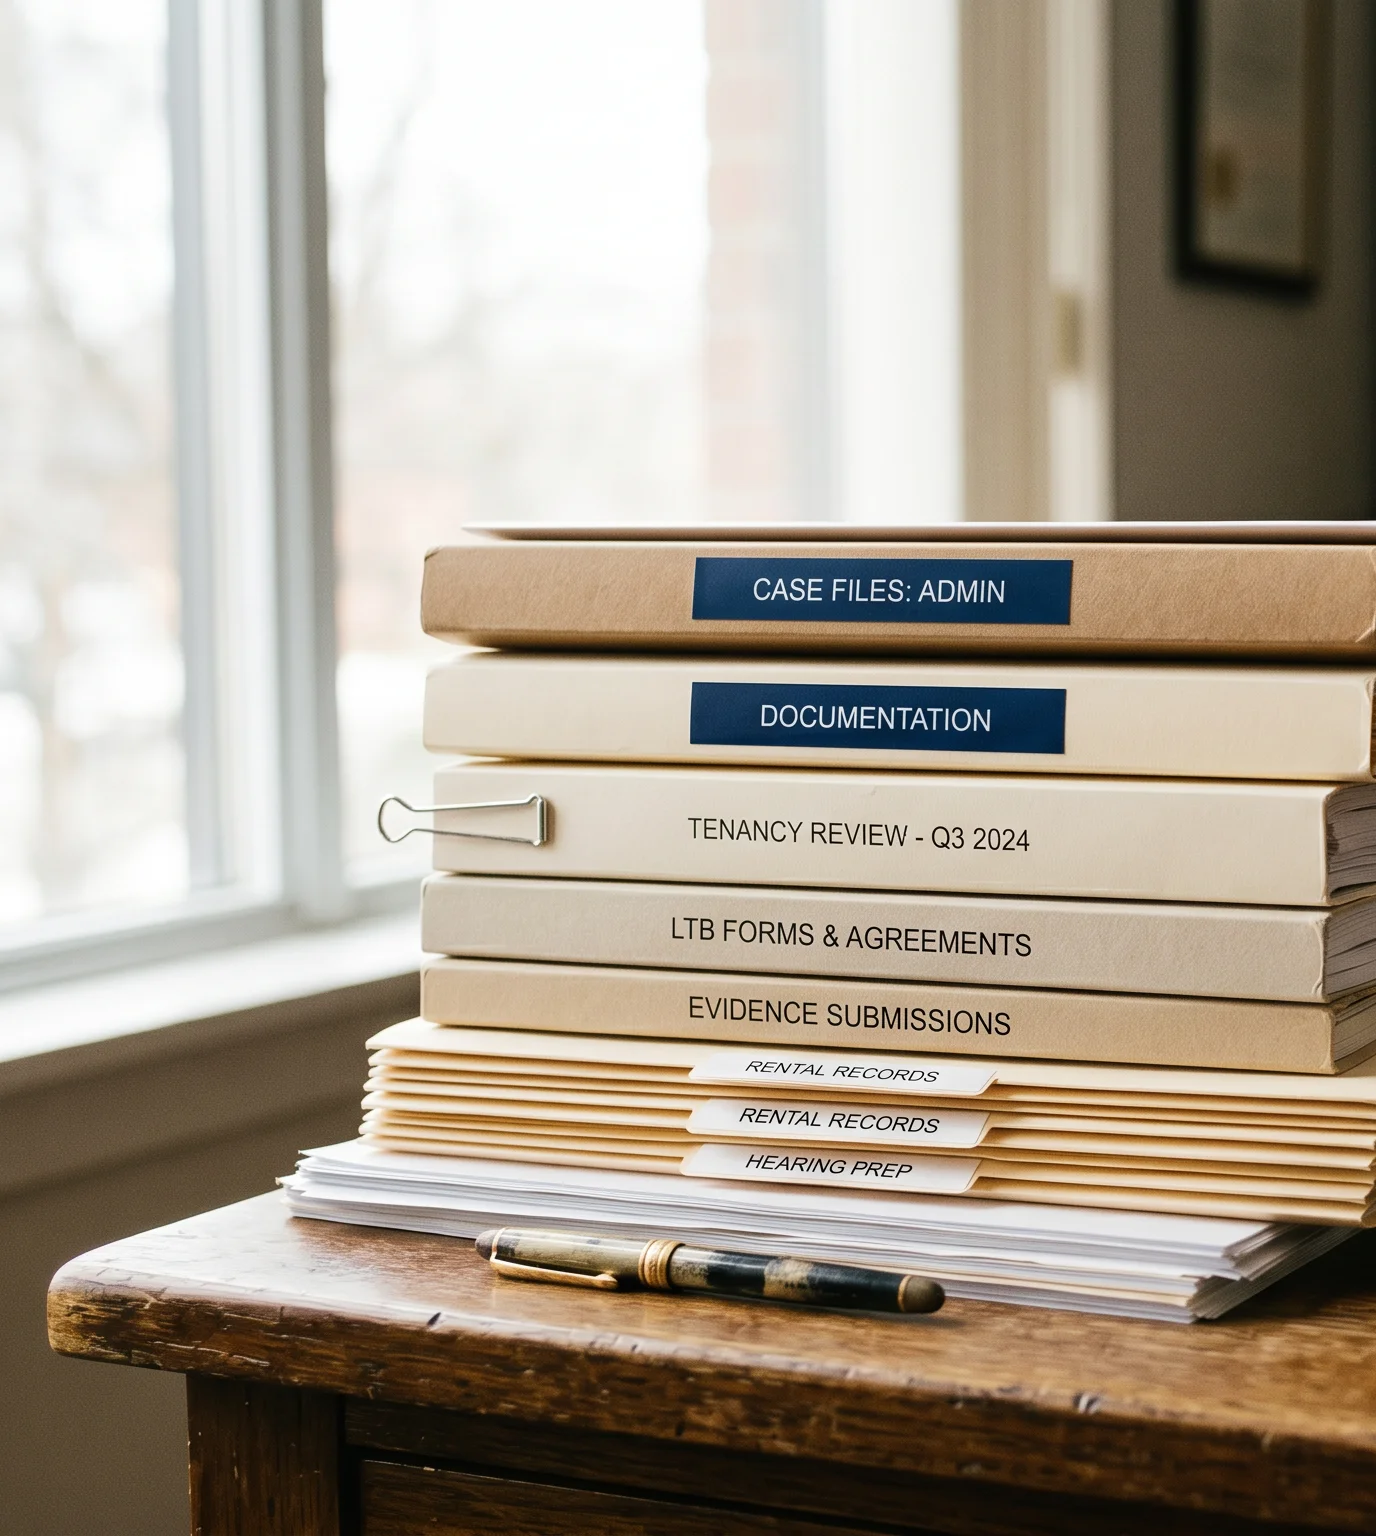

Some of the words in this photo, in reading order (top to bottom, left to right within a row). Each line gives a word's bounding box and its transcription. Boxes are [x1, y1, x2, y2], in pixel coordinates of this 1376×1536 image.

[753, 577, 824, 602] CASE
[830, 577, 912, 604] FILES:
[917, 579, 1006, 604] ADMIN
[760, 704, 991, 732] DOCUMENTATION
[687, 817, 804, 843] TENANCY
[811, 821, 909, 847] REVIEW
[931, 825, 965, 850] Q3
[973, 827, 1030, 852] 2024
[671, 916, 715, 941] LTB
[723, 919, 815, 947] FORMS
[822, 924, 840, 948] &
[845, 925, 1032, 958] AGREEMENTS
[689, 995, 819, 1026] EVIDENCE
[826, 1003, 1011, 1036] SUBMISSIONS
[744, 1060, 826, 1077] RENTAL
[832, 1066, 940, 1083] RECORDS
[739, 1108, 822, 1127] RENTAL
[828, 1113, 940, 1134] RECORDS
[745, 1154, 847, 1175] HEARING
[850, 1161, 913, 1179] PREP
